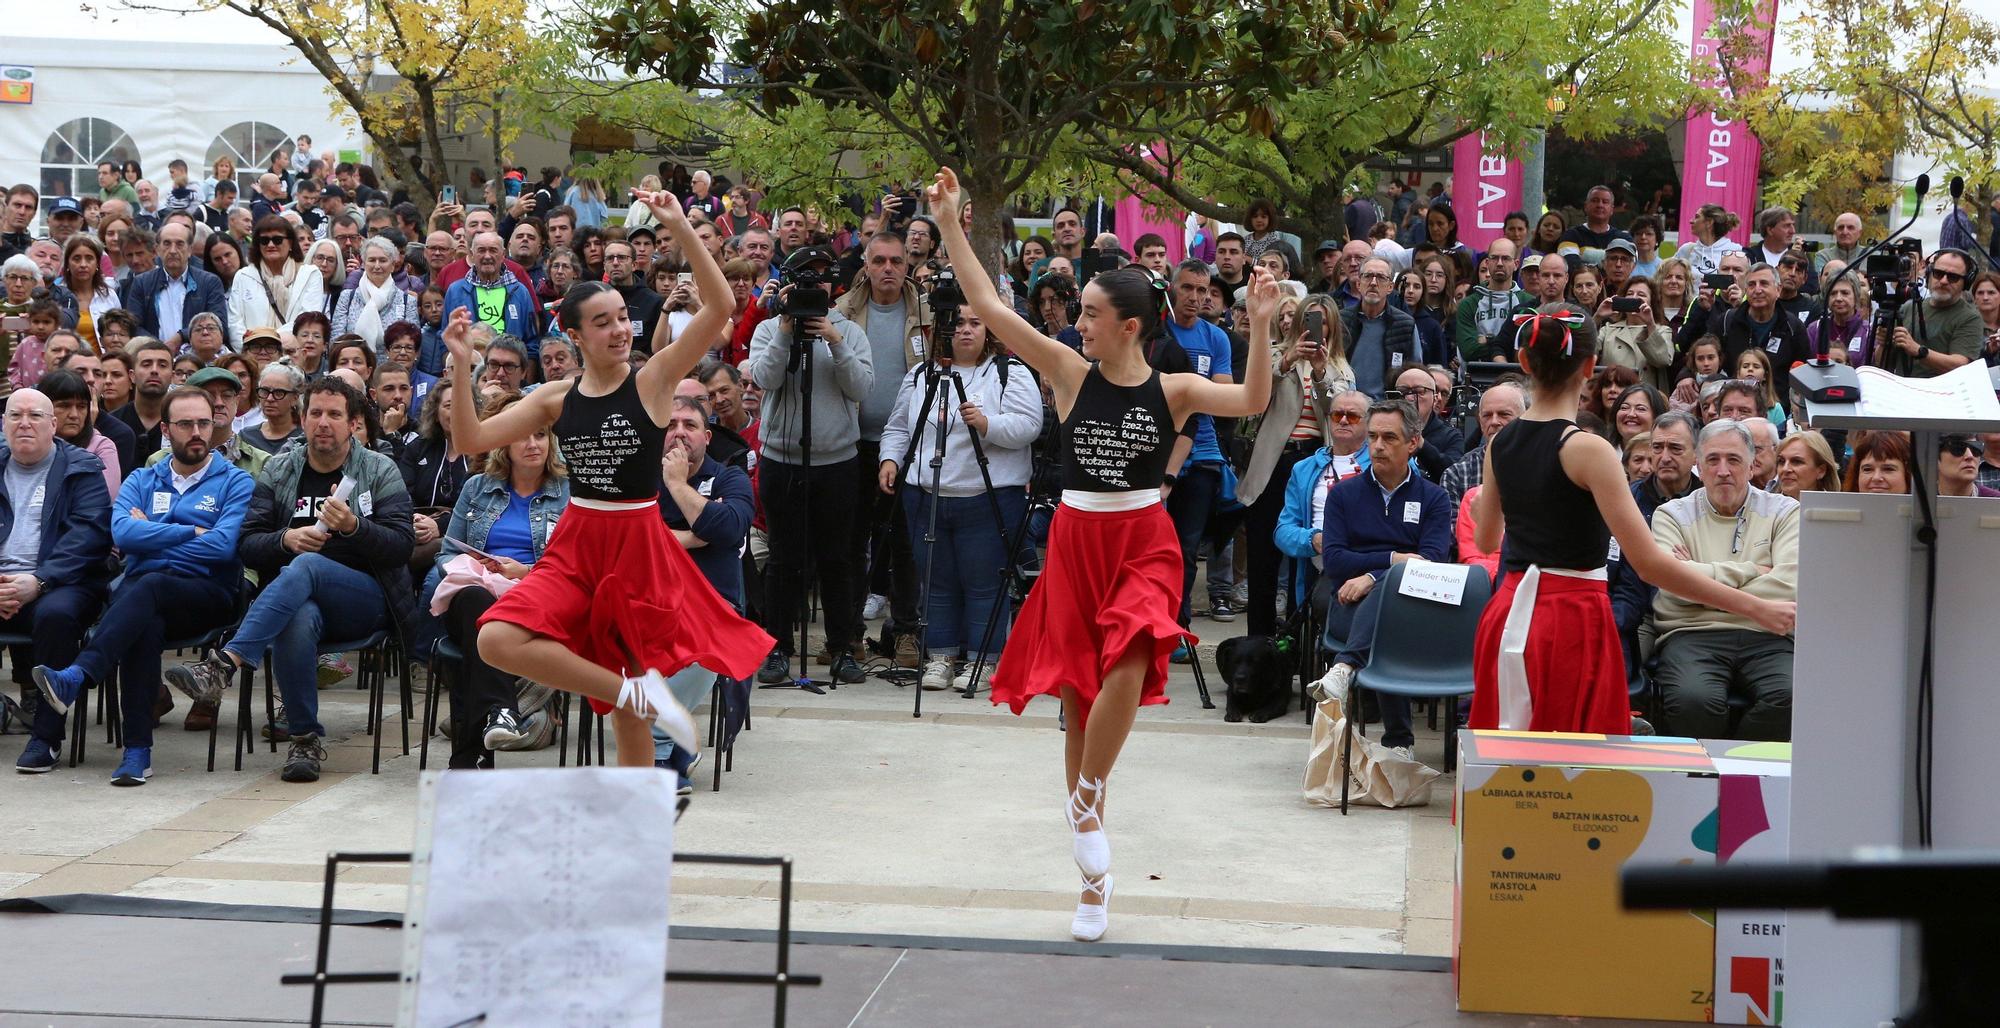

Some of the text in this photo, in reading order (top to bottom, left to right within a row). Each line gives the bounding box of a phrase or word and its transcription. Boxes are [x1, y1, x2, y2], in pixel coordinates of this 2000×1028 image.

[1410, 569, 1461, 584] Maider Nuin
[1482, 789, 1573, 800] LABIAGA IKASTOLA
[1516, 801, 1539, 810] BERA
[1552, 812, 1640, 823] BAZTAN IKASTOLA
[1573, 824, 1618, 833] ELIZONDO
[1491, 871, 1562, 881] TANTIRUMAIRU
[1490, 883, 1537, 891] IKASTOLA
[1490, 894, 1524, 902] LESAKA
[1743, 924, 1786, 936] EREN
[1775, 958, 1784, 971] N
